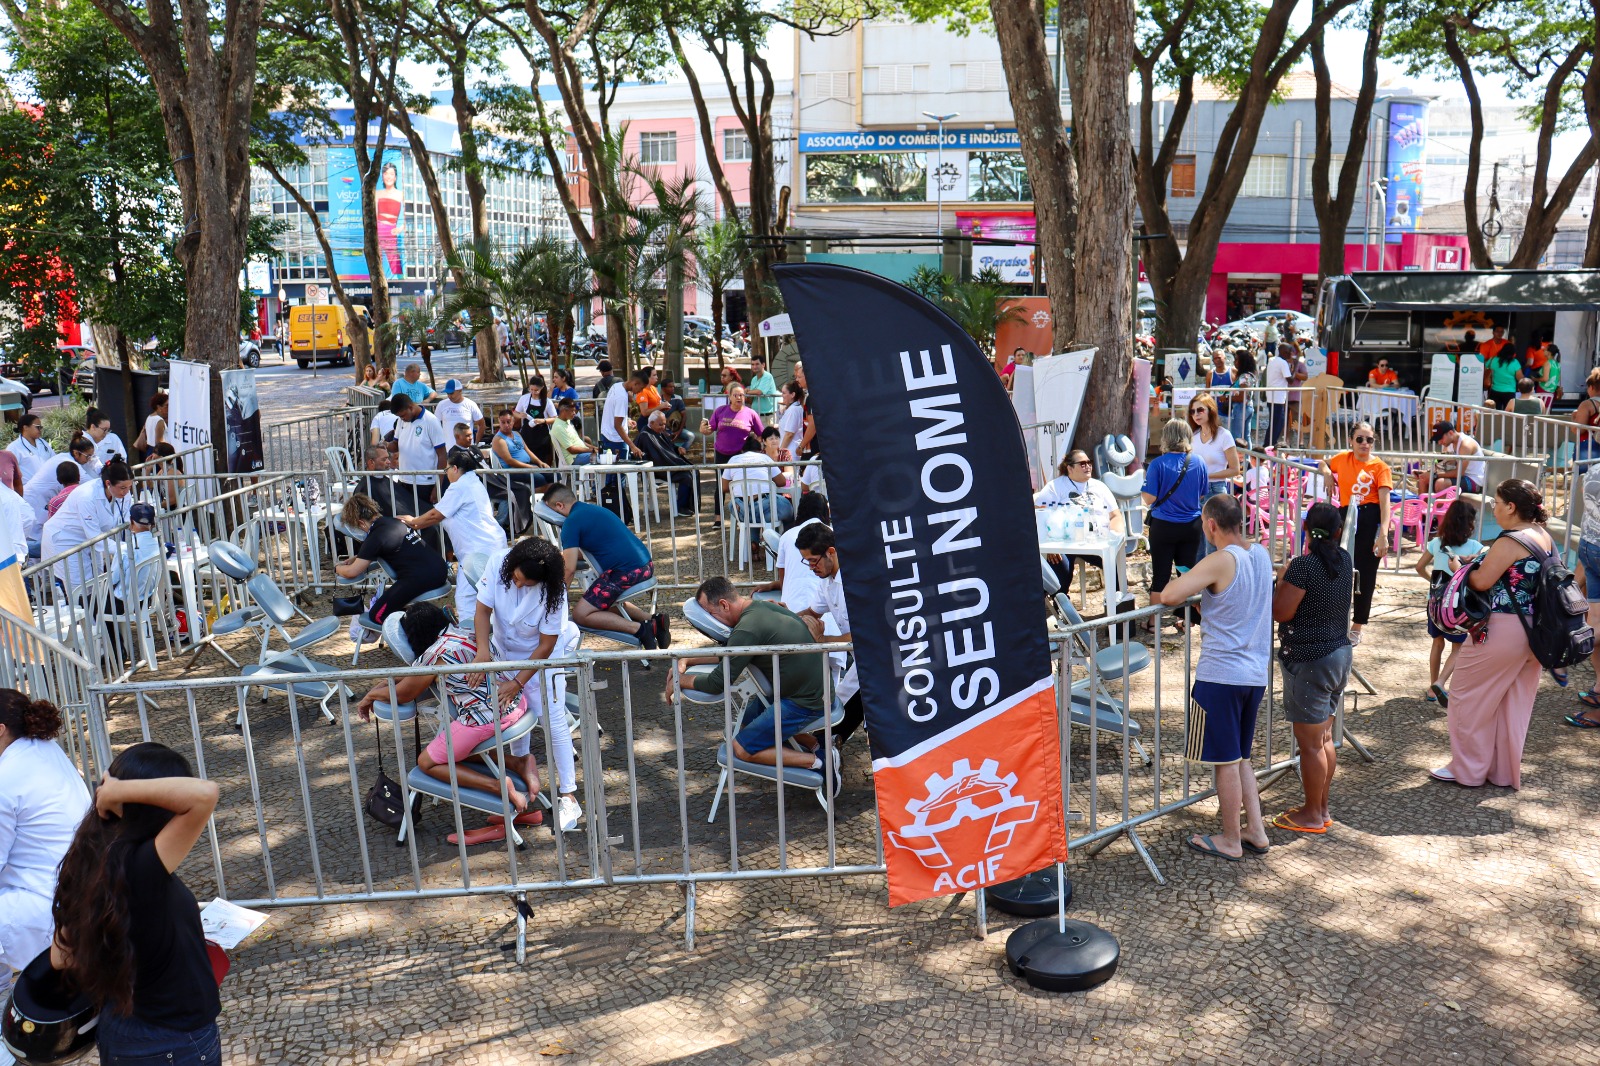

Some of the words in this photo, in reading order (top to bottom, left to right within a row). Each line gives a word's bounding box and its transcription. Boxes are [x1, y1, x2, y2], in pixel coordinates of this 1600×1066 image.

[806, 133, 875, 149] ASSOCIAÇÃO
[878, 136, 896, 146] DO
[899, 131, 957, 146] COMÉRCIO
[960, 134, 967, 144] E
[969, 130, 1020, 144] INDÚSTR
[980, 256, 1027, 267] Paraíso
[1016, 268, 1030, 277] das
[173, 421, 210, 445] EÉTICA
[900, 343, 982, 556] NOME
[881, 516, 938, 723] CONSULTE
[938, 577, 1000, 710] SEU
[933, 853, 1003, 892] ACIF
